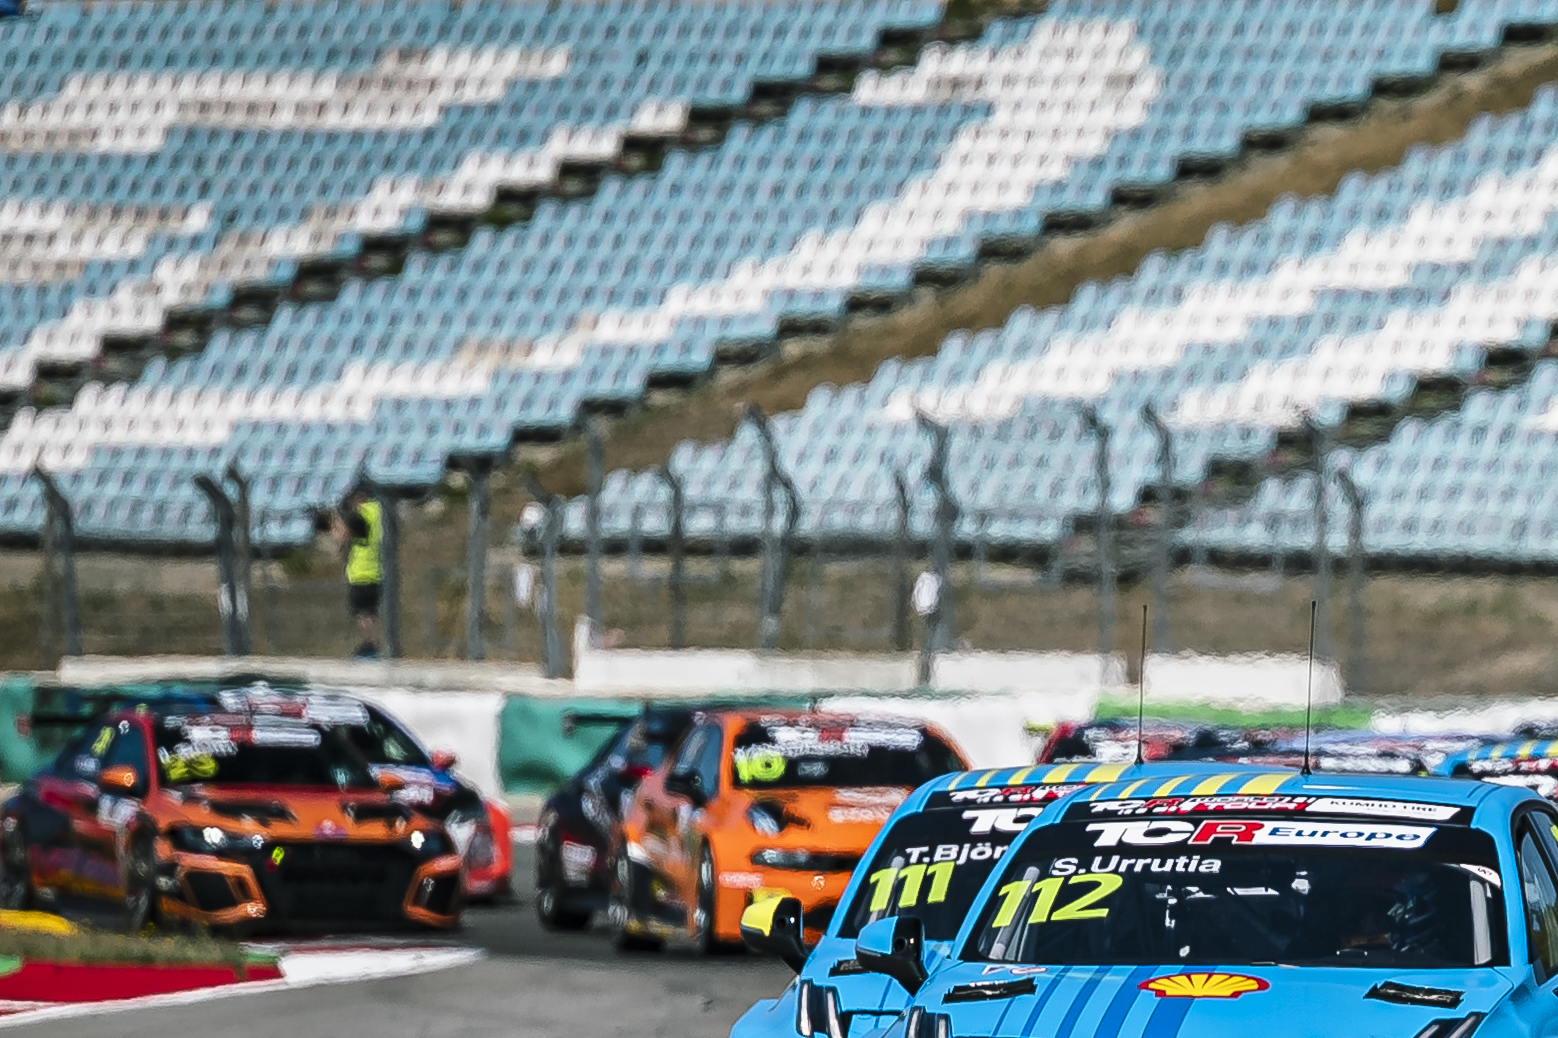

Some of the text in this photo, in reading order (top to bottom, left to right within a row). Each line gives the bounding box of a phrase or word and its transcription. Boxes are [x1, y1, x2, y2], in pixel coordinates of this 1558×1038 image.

[1086, 819, 1421, 847] TCR Europe
[1051, 855, 1221, 877] S.Urrutia
[869, 861, 955, 912] 111
[992, 872, 1123, 928] 112
